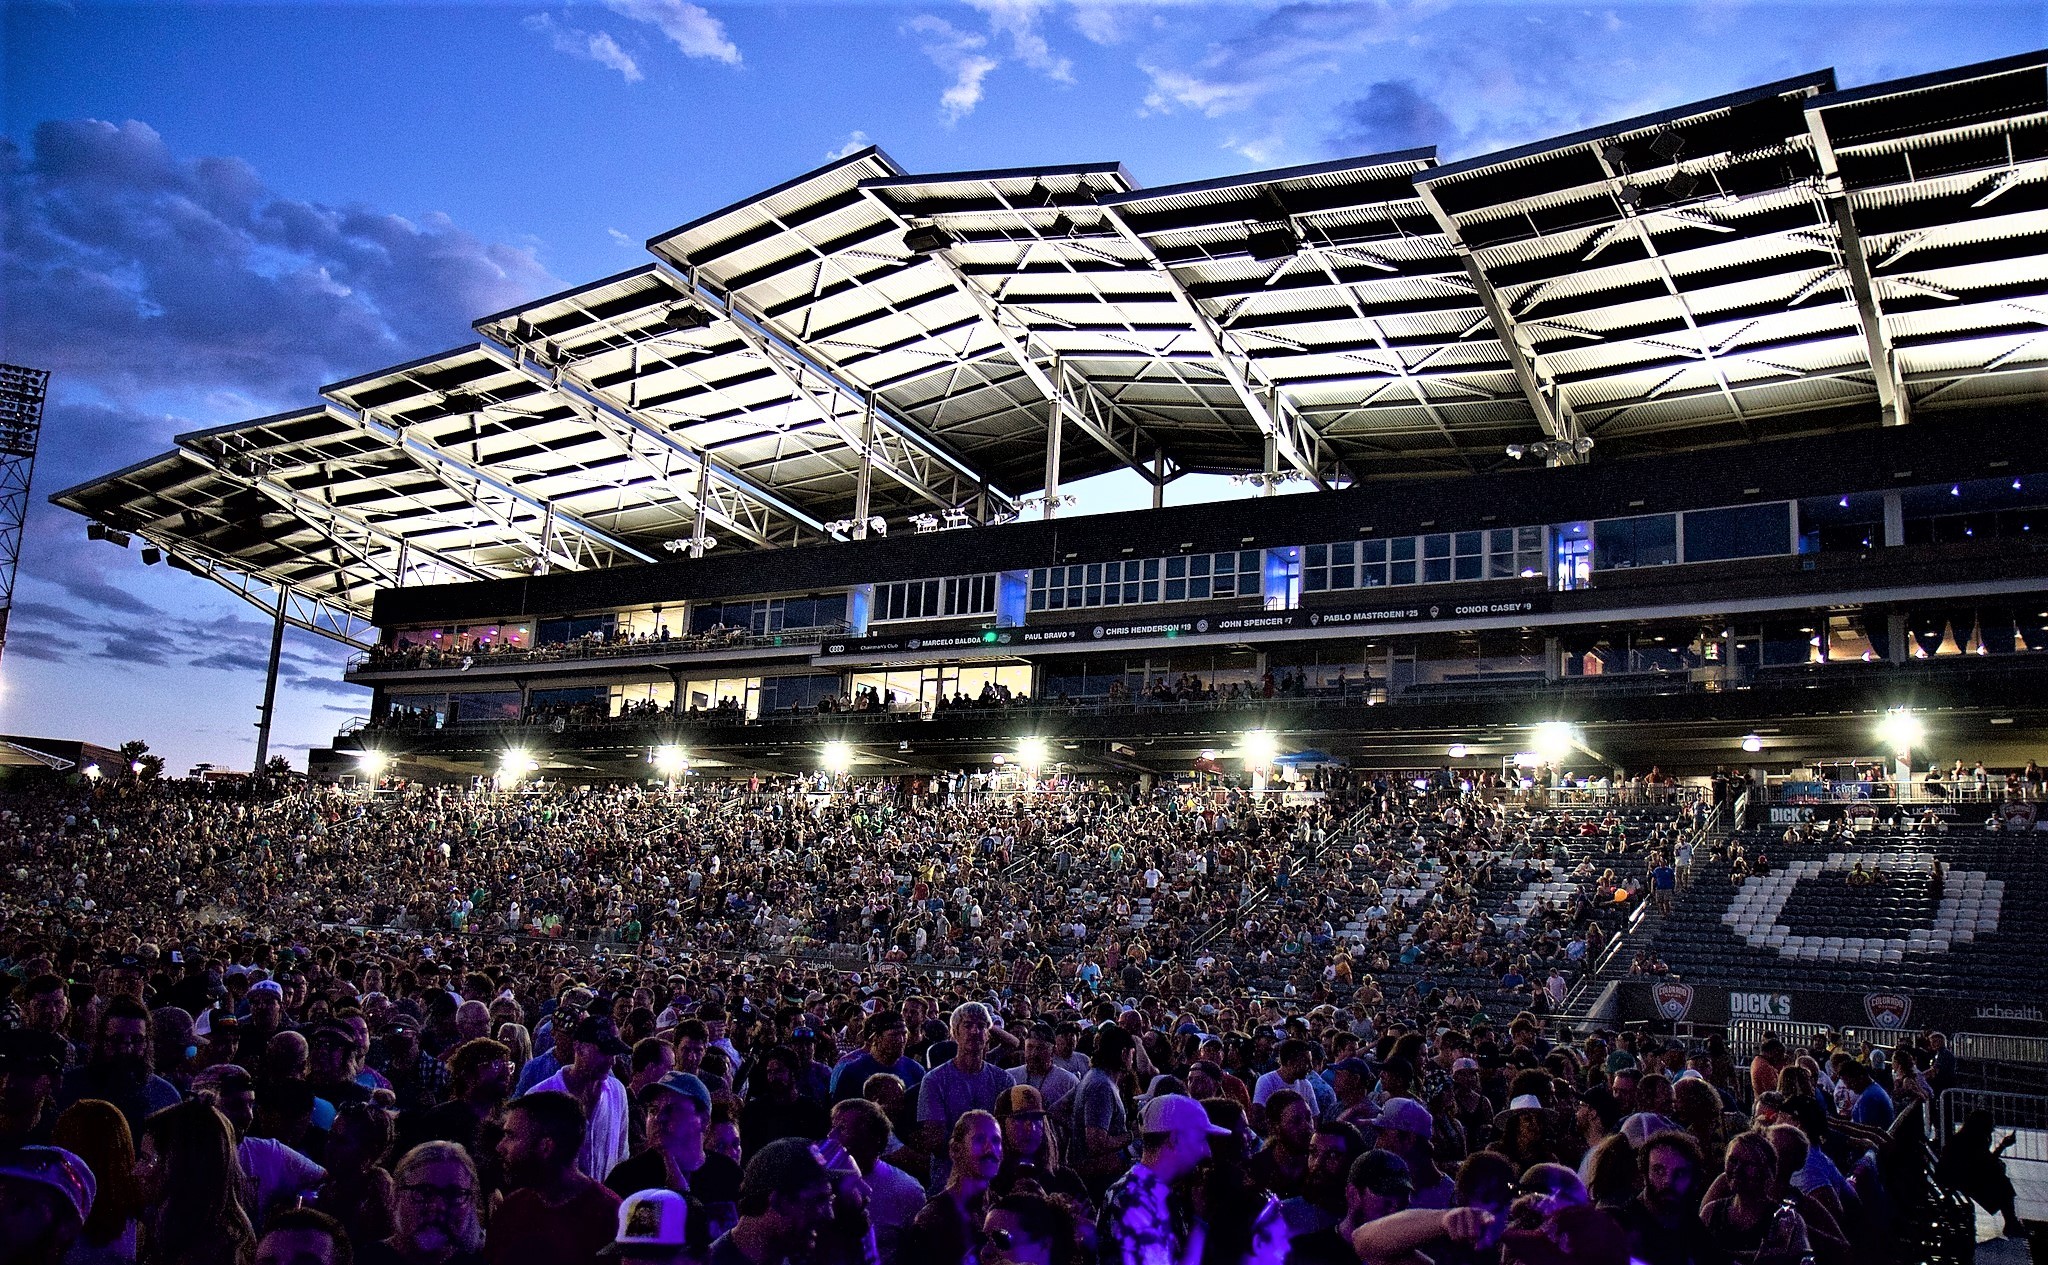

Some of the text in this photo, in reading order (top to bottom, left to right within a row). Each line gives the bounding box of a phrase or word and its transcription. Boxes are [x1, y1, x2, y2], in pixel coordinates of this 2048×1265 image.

[1455, 605, 1489, 614] CONOR
[1490, 603, 1522, 612] CASEY
[1323, 609, 1419, 623] PABLO MASTROENI #25
[1105, 623, 1192, 635] CHRIS HENDERSON #19
[1219, 617, 1293, 629] JOHN SPENCER #7
[922, 638, 954, 647] MARCELO
[954, 636, 981, 645] BALBOA
[1024, 633, 1043, 641] PAUL
[1043, 631, 1068, 639] BRAVO
[1730, 992, 1791, 1015] DICK'S
[1976, 1003, 2043, 1021] uchealth
